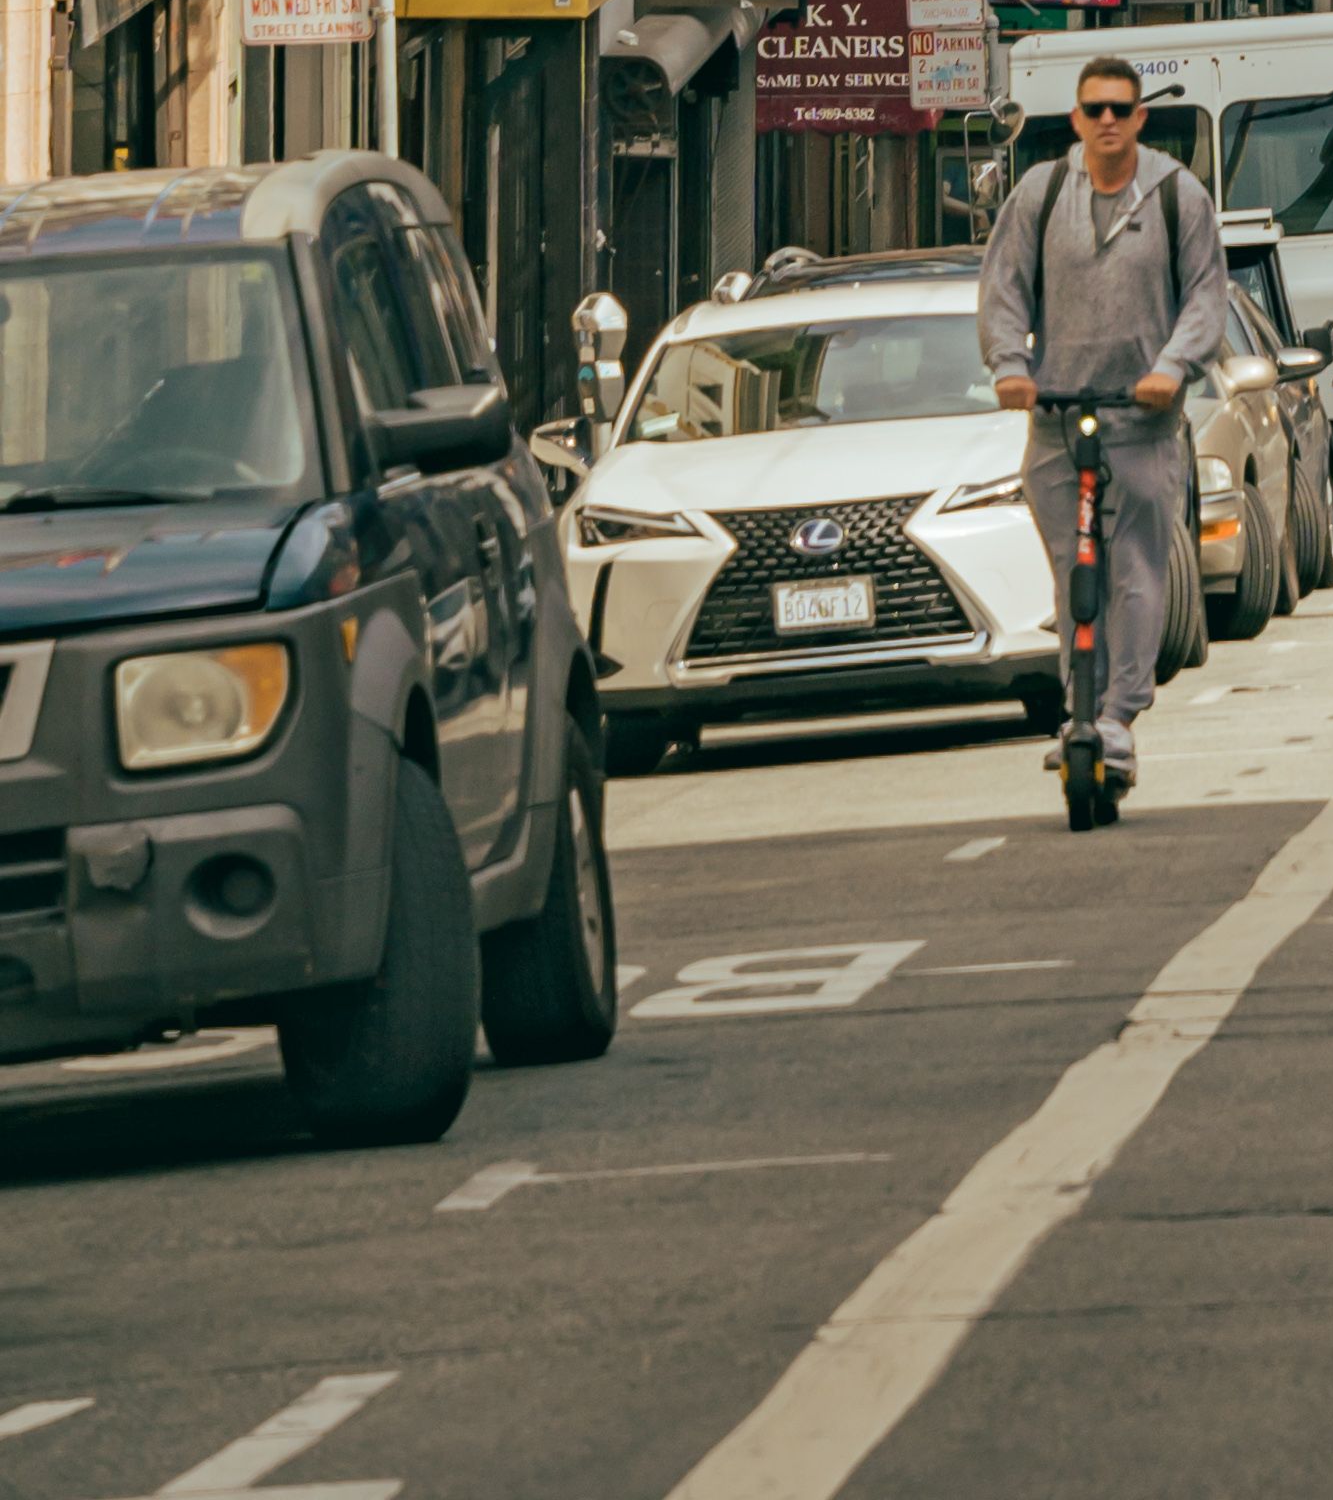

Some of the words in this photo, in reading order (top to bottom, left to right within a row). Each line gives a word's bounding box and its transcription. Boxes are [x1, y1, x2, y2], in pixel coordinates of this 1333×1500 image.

[804, 3, 833, 28] K.
[841, 2, 868, 27] Y.
[252, 22, 298, 38] STREET
[302, 21, 365, 37] CLEANING
[757, 36, 905, 60] CLEANERS
[911, 32, 933, 55] NO
[936, 34, 983, 51] PARKING
[756, 73, 801, 88] SAME
[806, 73, 841, 88] DAY
[844, 72, 910, 88] SERVICE
